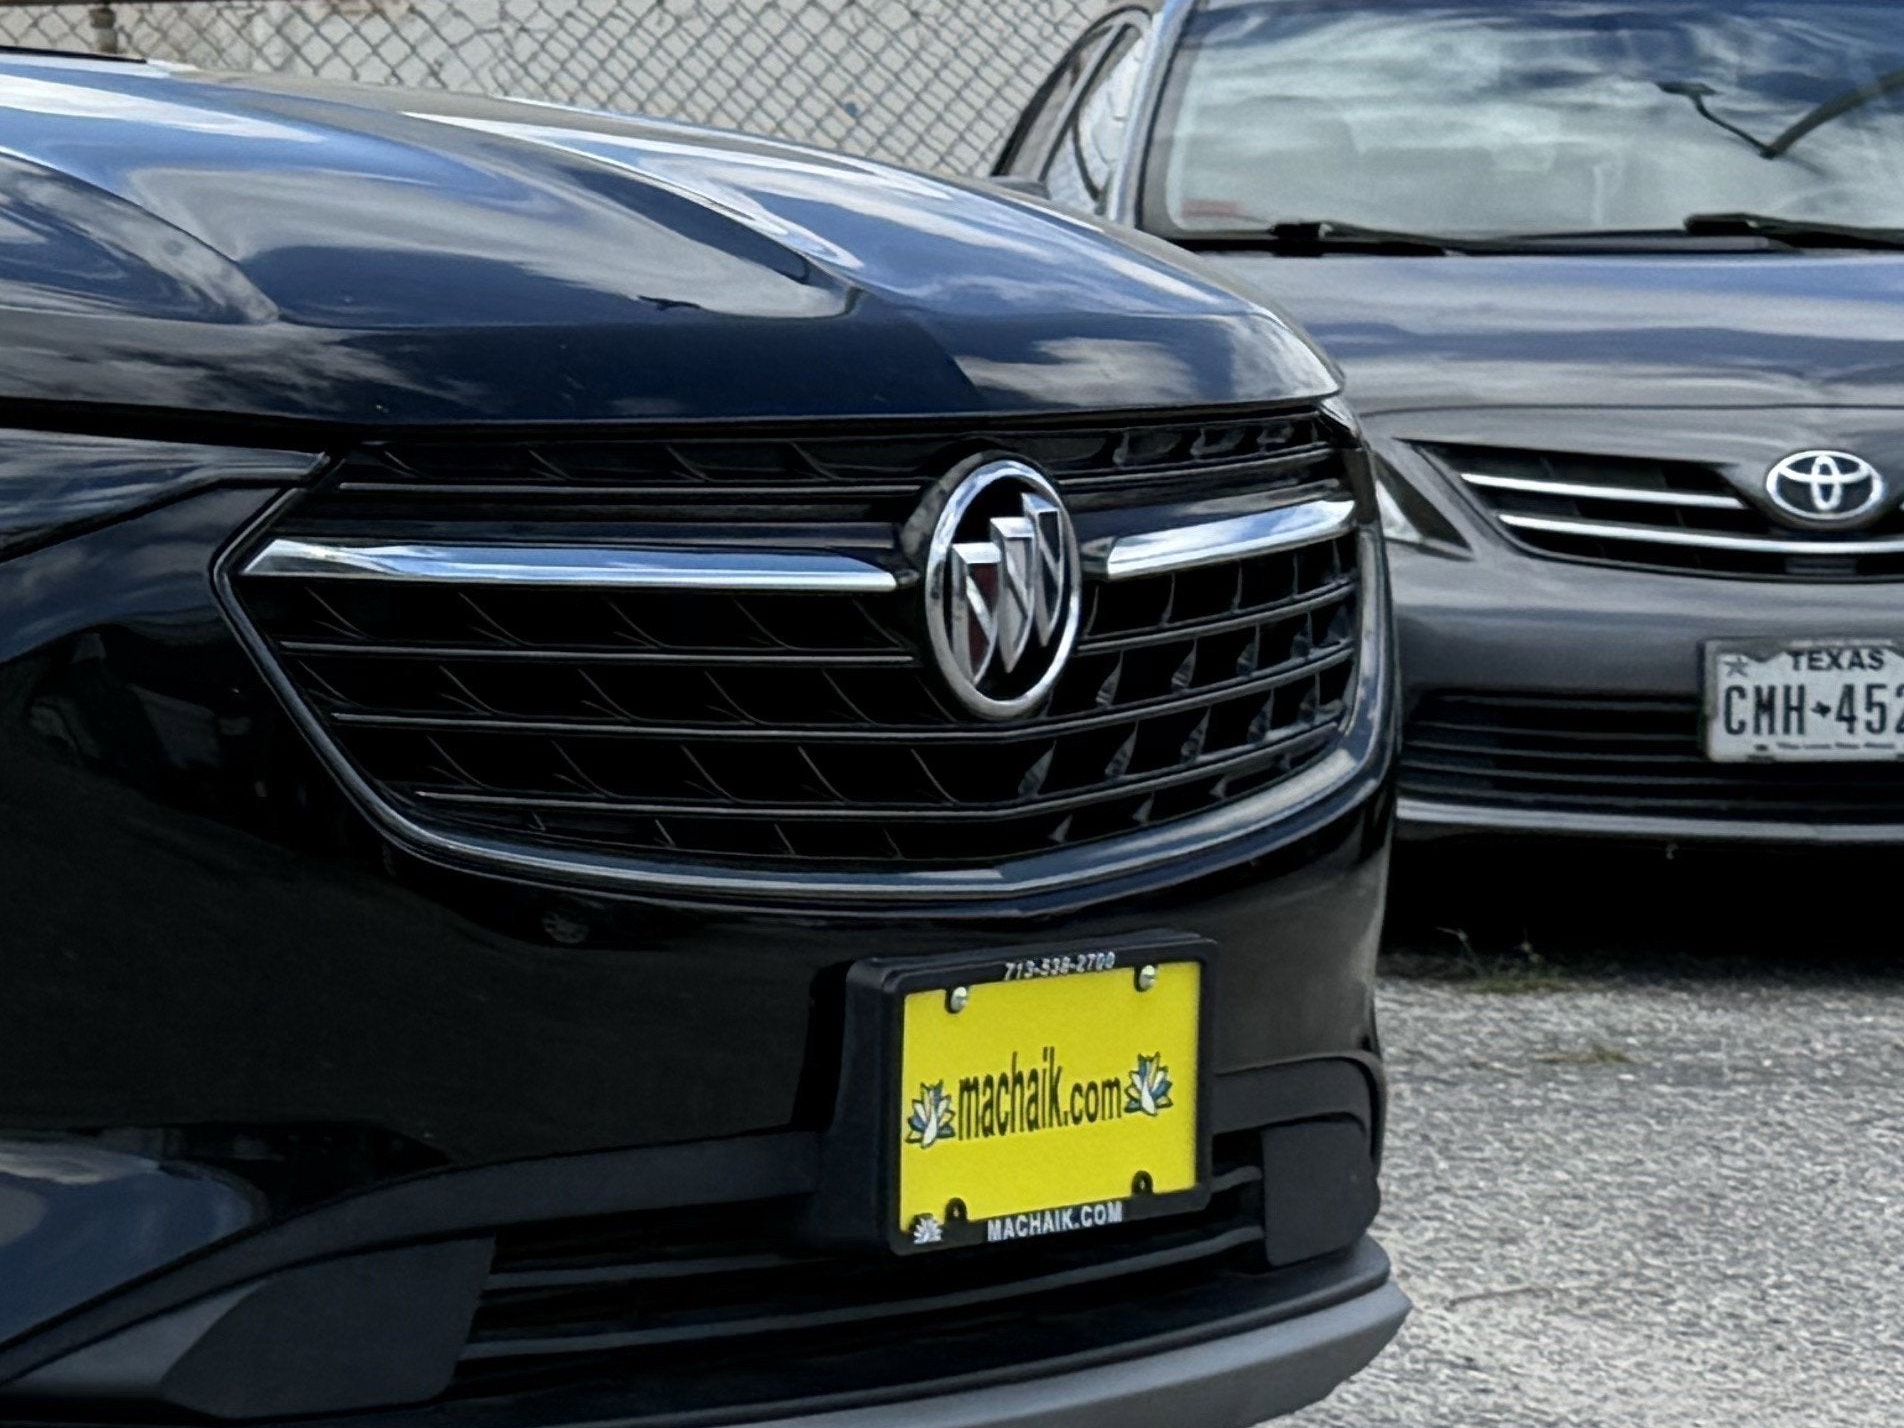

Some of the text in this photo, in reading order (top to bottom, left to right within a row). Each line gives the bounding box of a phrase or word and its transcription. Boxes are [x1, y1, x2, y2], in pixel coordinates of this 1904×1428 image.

[1792, 648, 1885, 671] TEXAS
[958, 1046, 1121, 1141] machaik.com
[987, 1201, 1123, 1242] MACHAIK.COM
